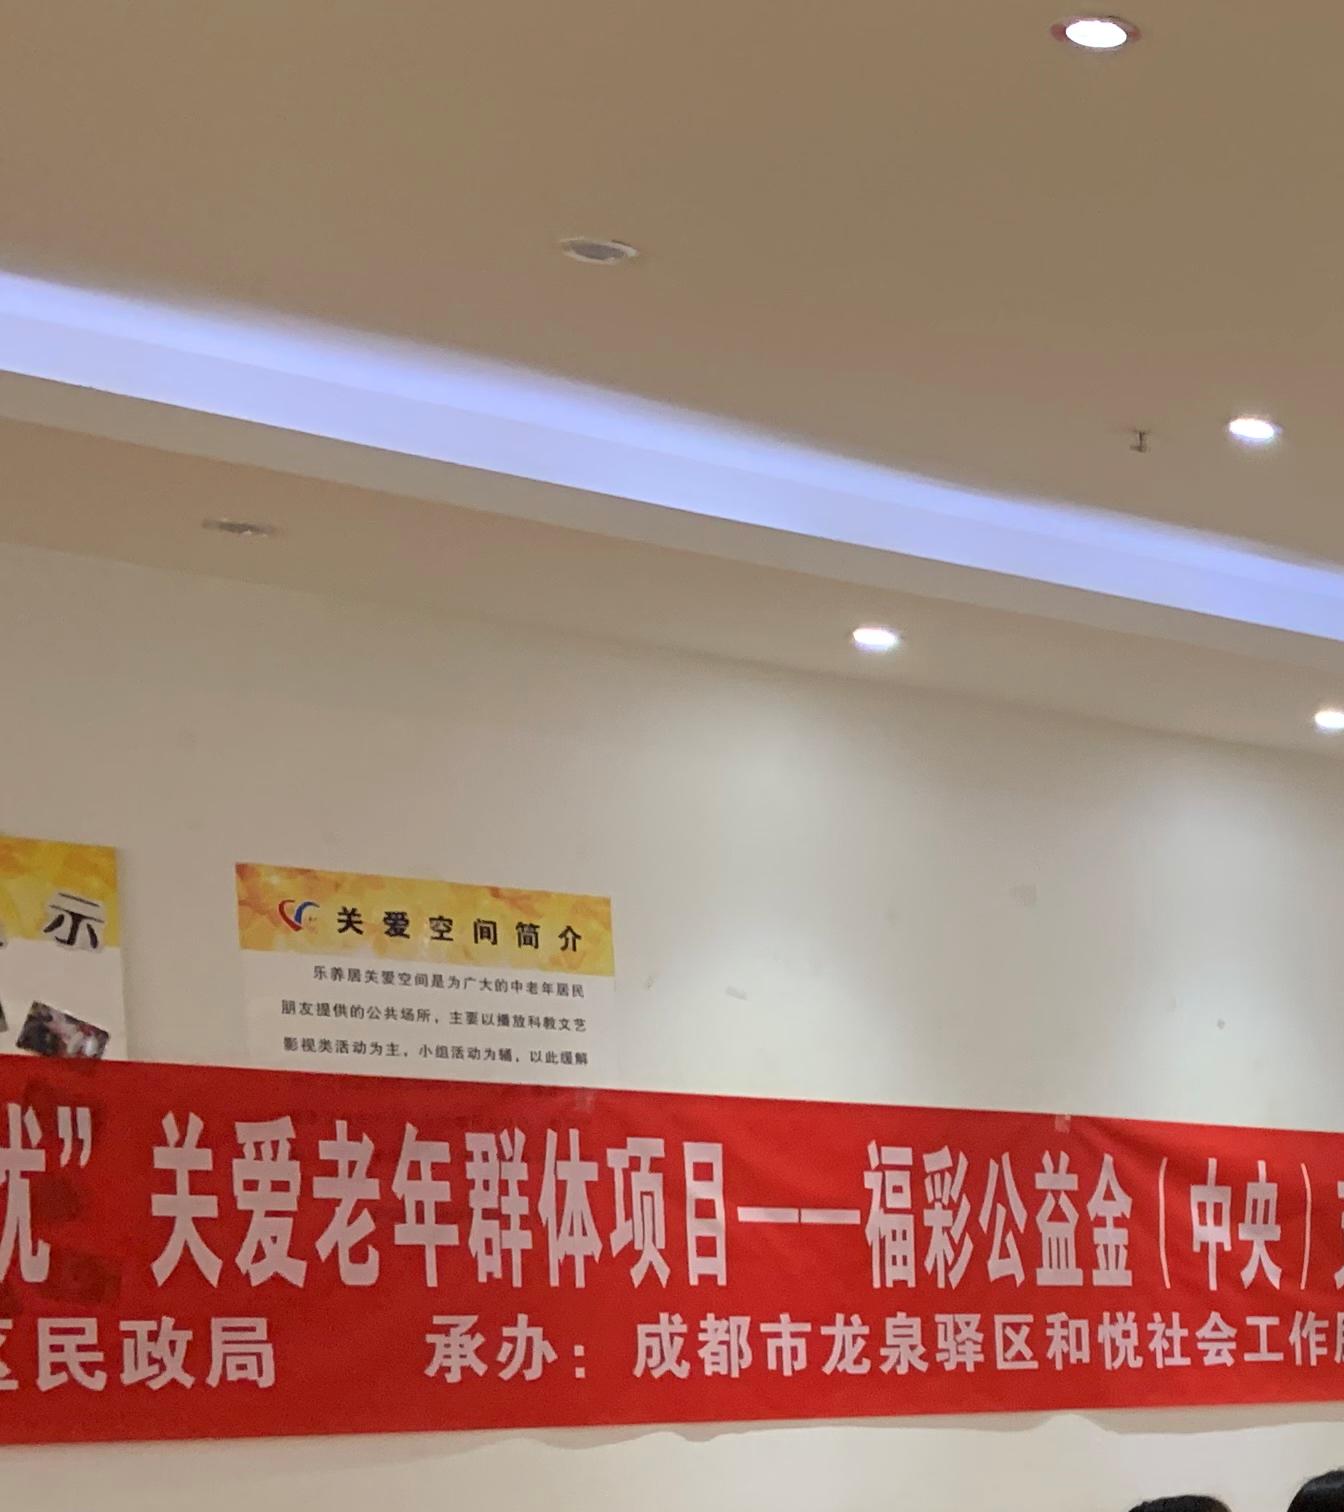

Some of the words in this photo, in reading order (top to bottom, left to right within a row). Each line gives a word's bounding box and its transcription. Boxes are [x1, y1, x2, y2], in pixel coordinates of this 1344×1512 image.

[43, 891, 105, 949] 示
[336, 906, 584, 953] 关爱空间简介
[313, 964, 586, 999] 乐养居关爱空间是为广大的中老年居民
